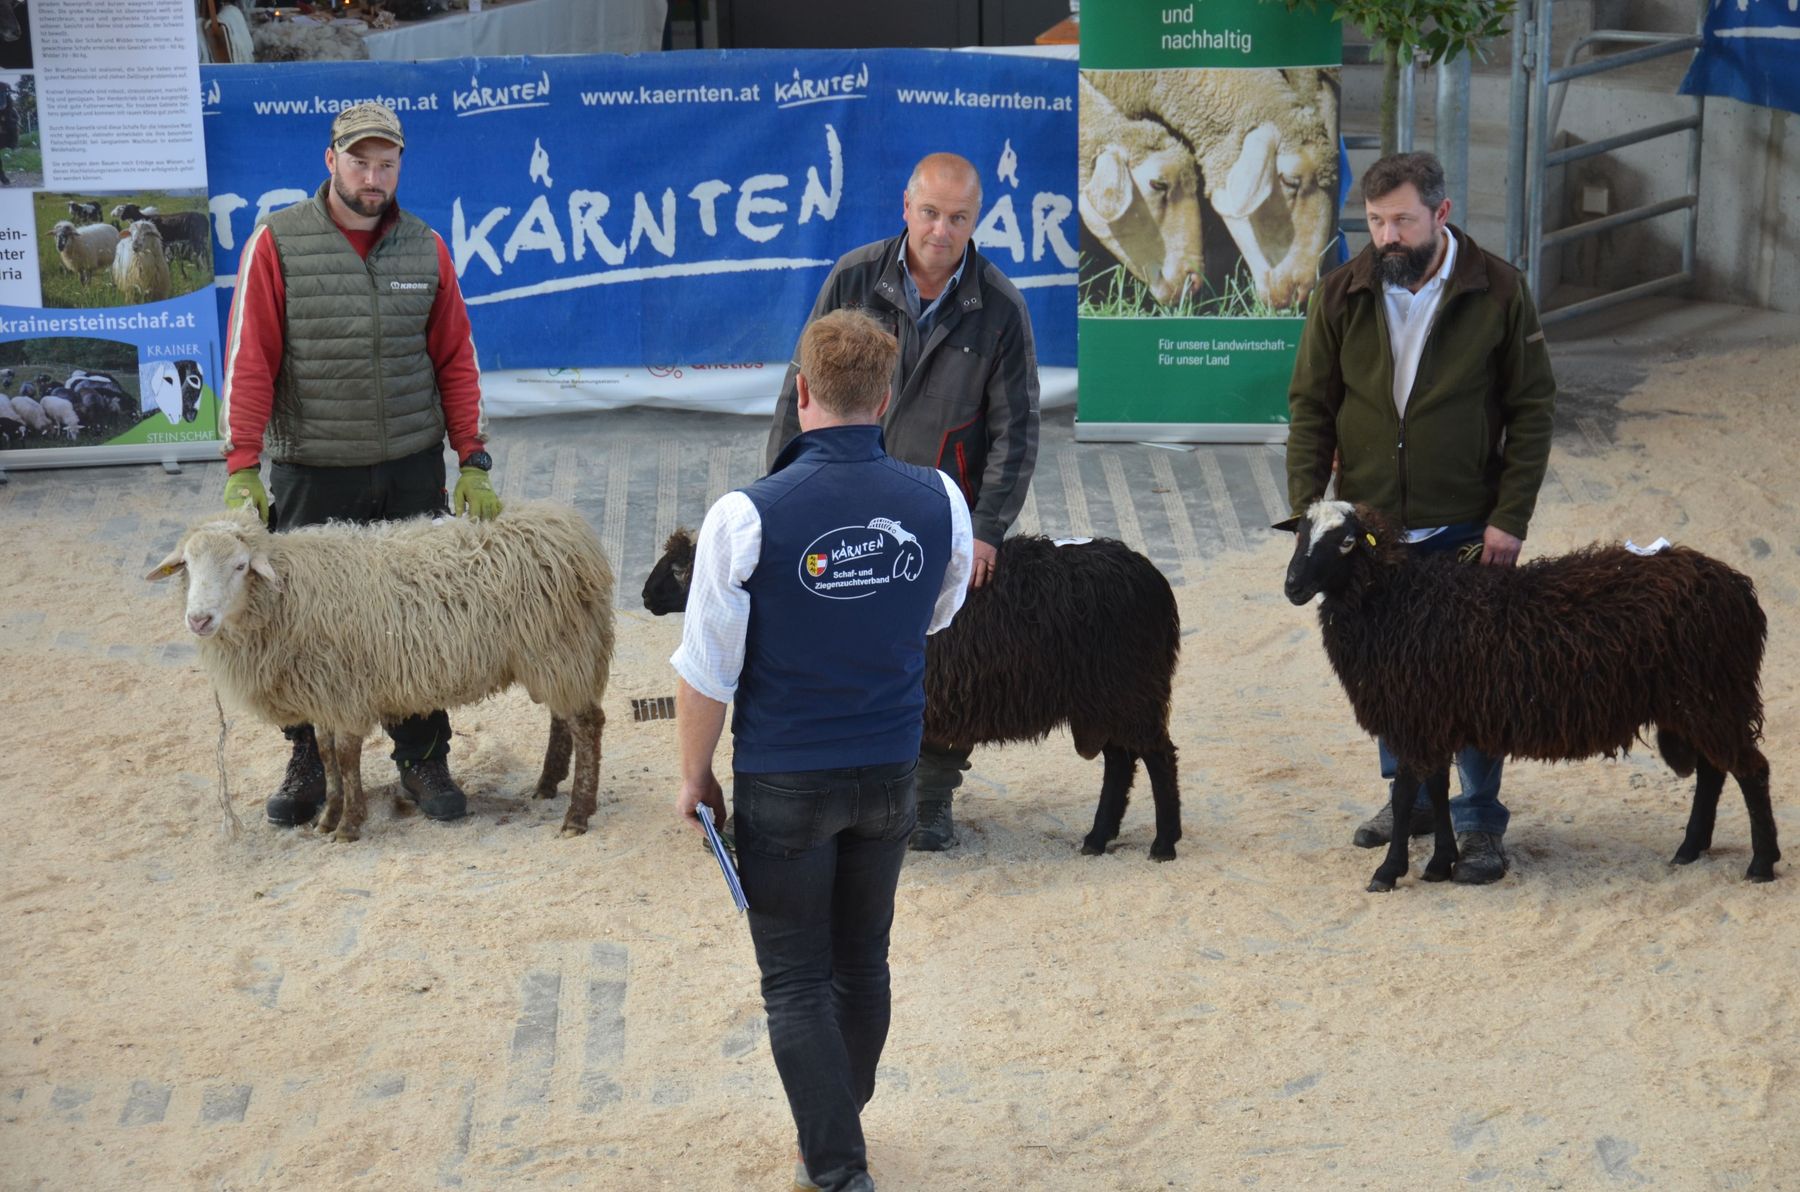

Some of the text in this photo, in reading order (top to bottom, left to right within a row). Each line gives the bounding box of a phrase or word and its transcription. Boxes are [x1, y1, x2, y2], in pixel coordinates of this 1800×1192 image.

[1162, 4, 1194, 24] und
[1162, 29, 1252, 54] nachhaltig
[580, 84, 760, 106] www.kaernten.at
[897, 88, 1072, 112] www.kaernten.at
[147, 344, 202, 357] KRAINER
[1159, 338, 1173, 350] Für
[1176, 341, 1209, 350] unsere
[1212, 338, 1285, 351] Landwirtschaft
[1159, 354, 1230, 366] Für unser Land
[833, 568, 873, 579] Schaf- und
[815, 576, 890, 590] Ziegenzuchtverband
